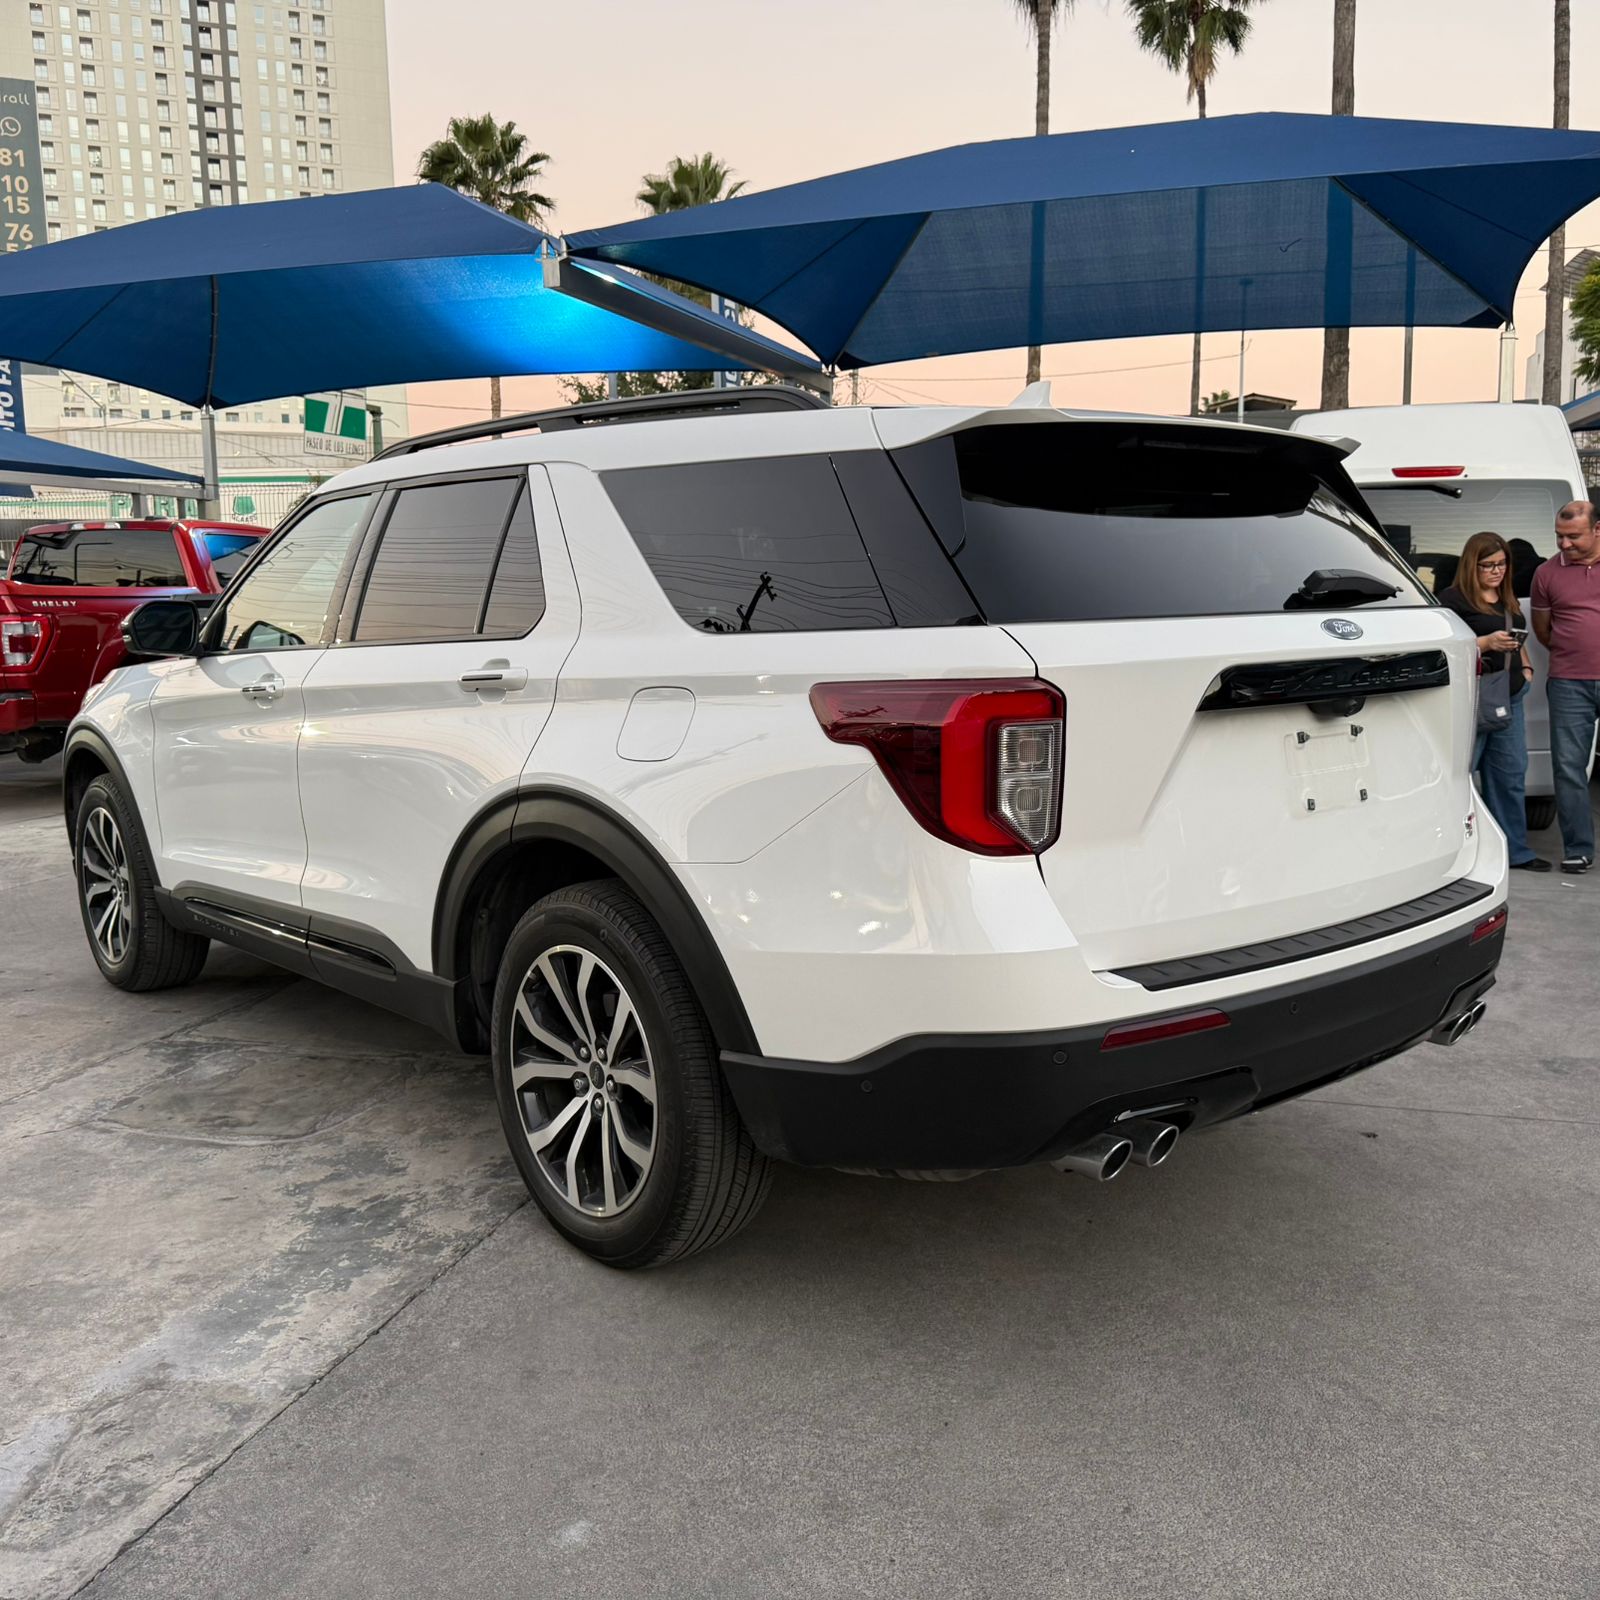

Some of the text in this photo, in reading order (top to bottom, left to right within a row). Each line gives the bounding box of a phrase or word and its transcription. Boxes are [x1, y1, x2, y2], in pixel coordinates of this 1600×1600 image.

[0, 93, 30, 106] rall
[0, 148, 25, 167] 81
[1, 175, 29, 193] 10
[3, 195, 31, 214] 15
[5, 223, 34, 242] 76
[305, 437, 323, 450] PASEO
[325, 439, 332, 451] DE
[334, 441, 344, 453] LOS
[31, 600, 77, 608] SHELBY
[1332, 620, 1357, 634] Ford
